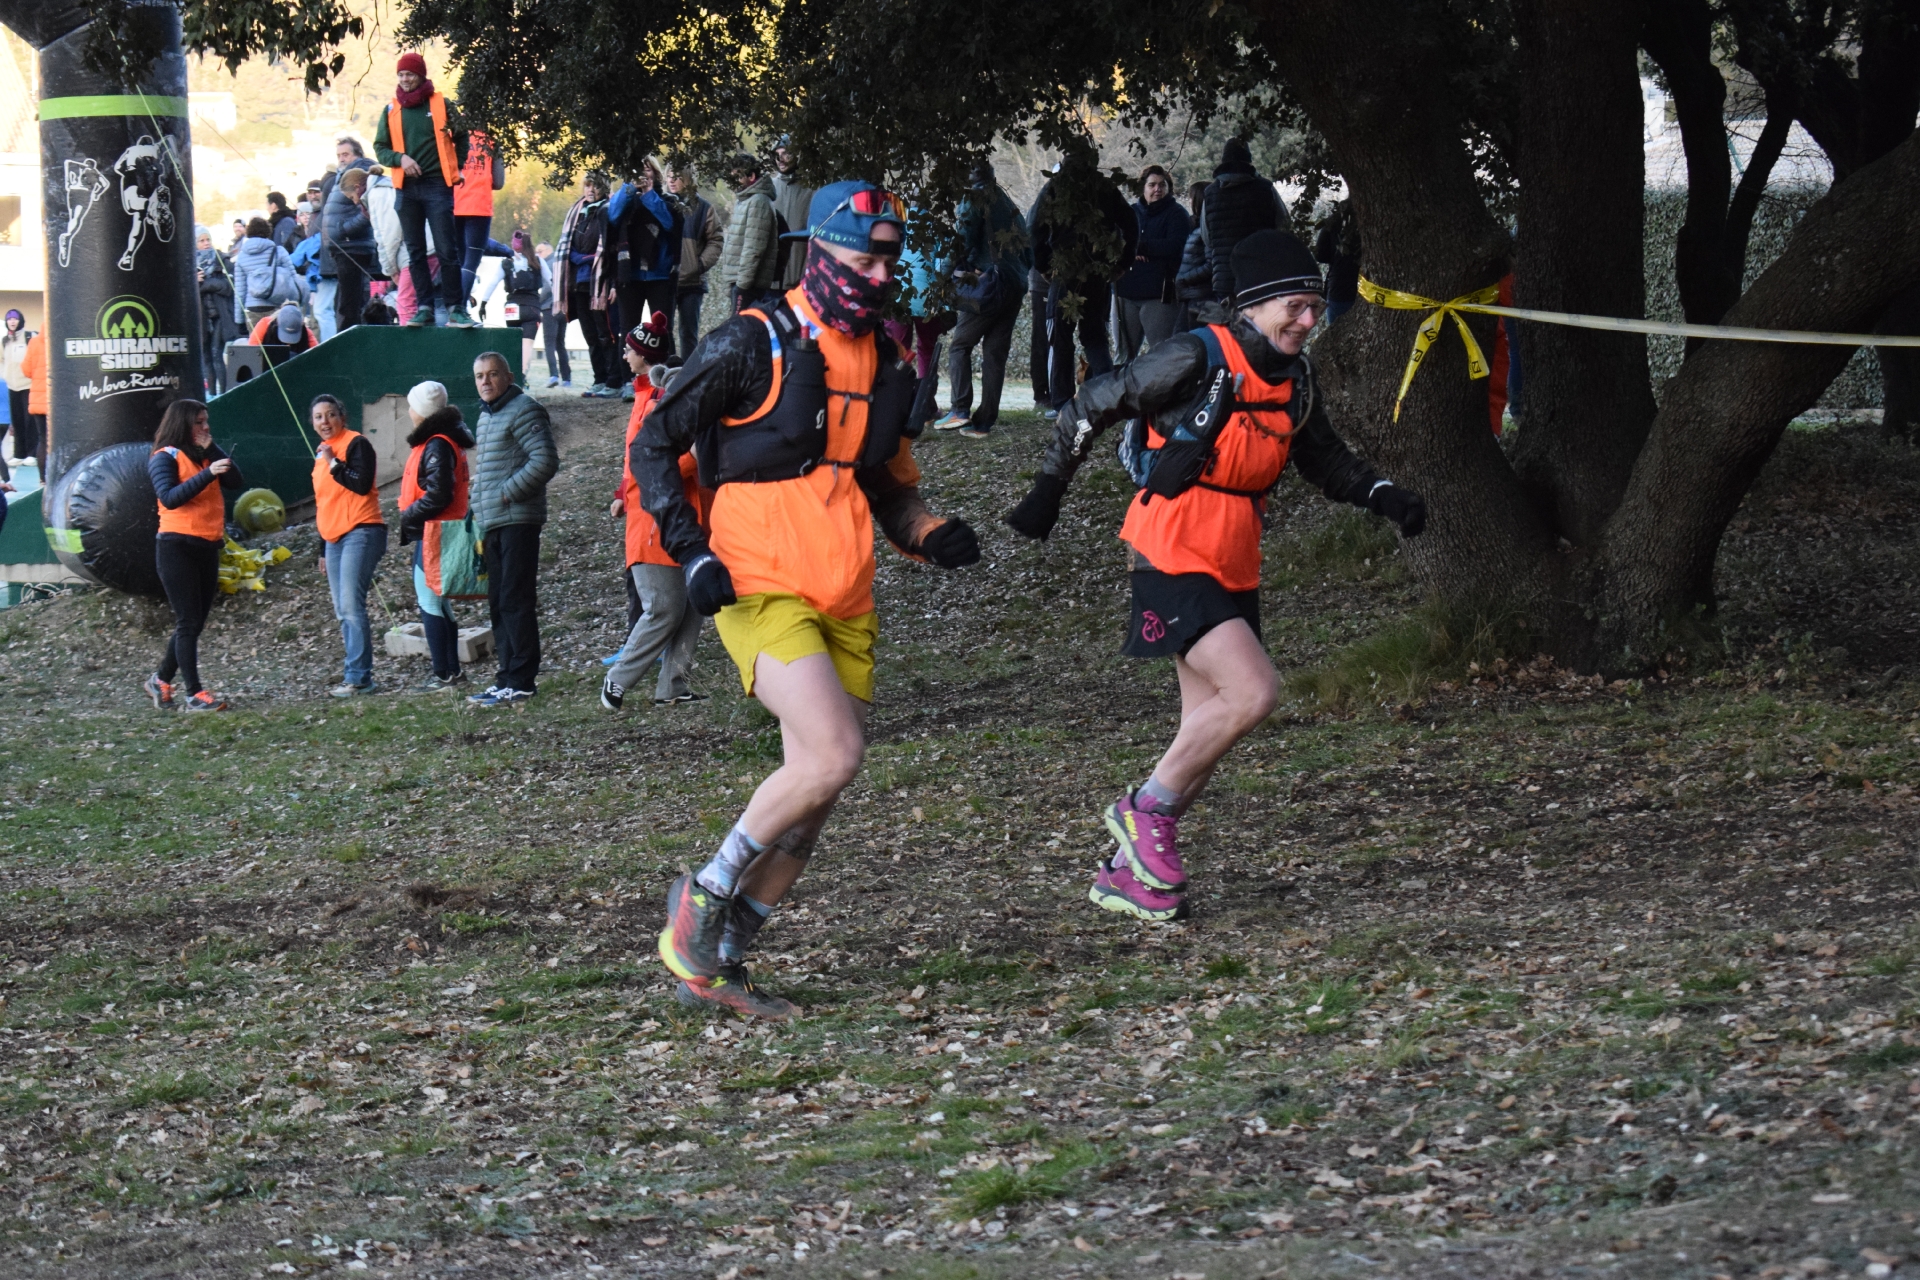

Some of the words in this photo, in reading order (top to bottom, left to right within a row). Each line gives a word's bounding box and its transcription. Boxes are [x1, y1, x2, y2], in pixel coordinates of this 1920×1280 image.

[66, 338, 187, 355] ENDURANCE
[101, 354, 158, 369] SHOP
[79, 380, 102, 400] We
[130, 372, 180, 390] Running
